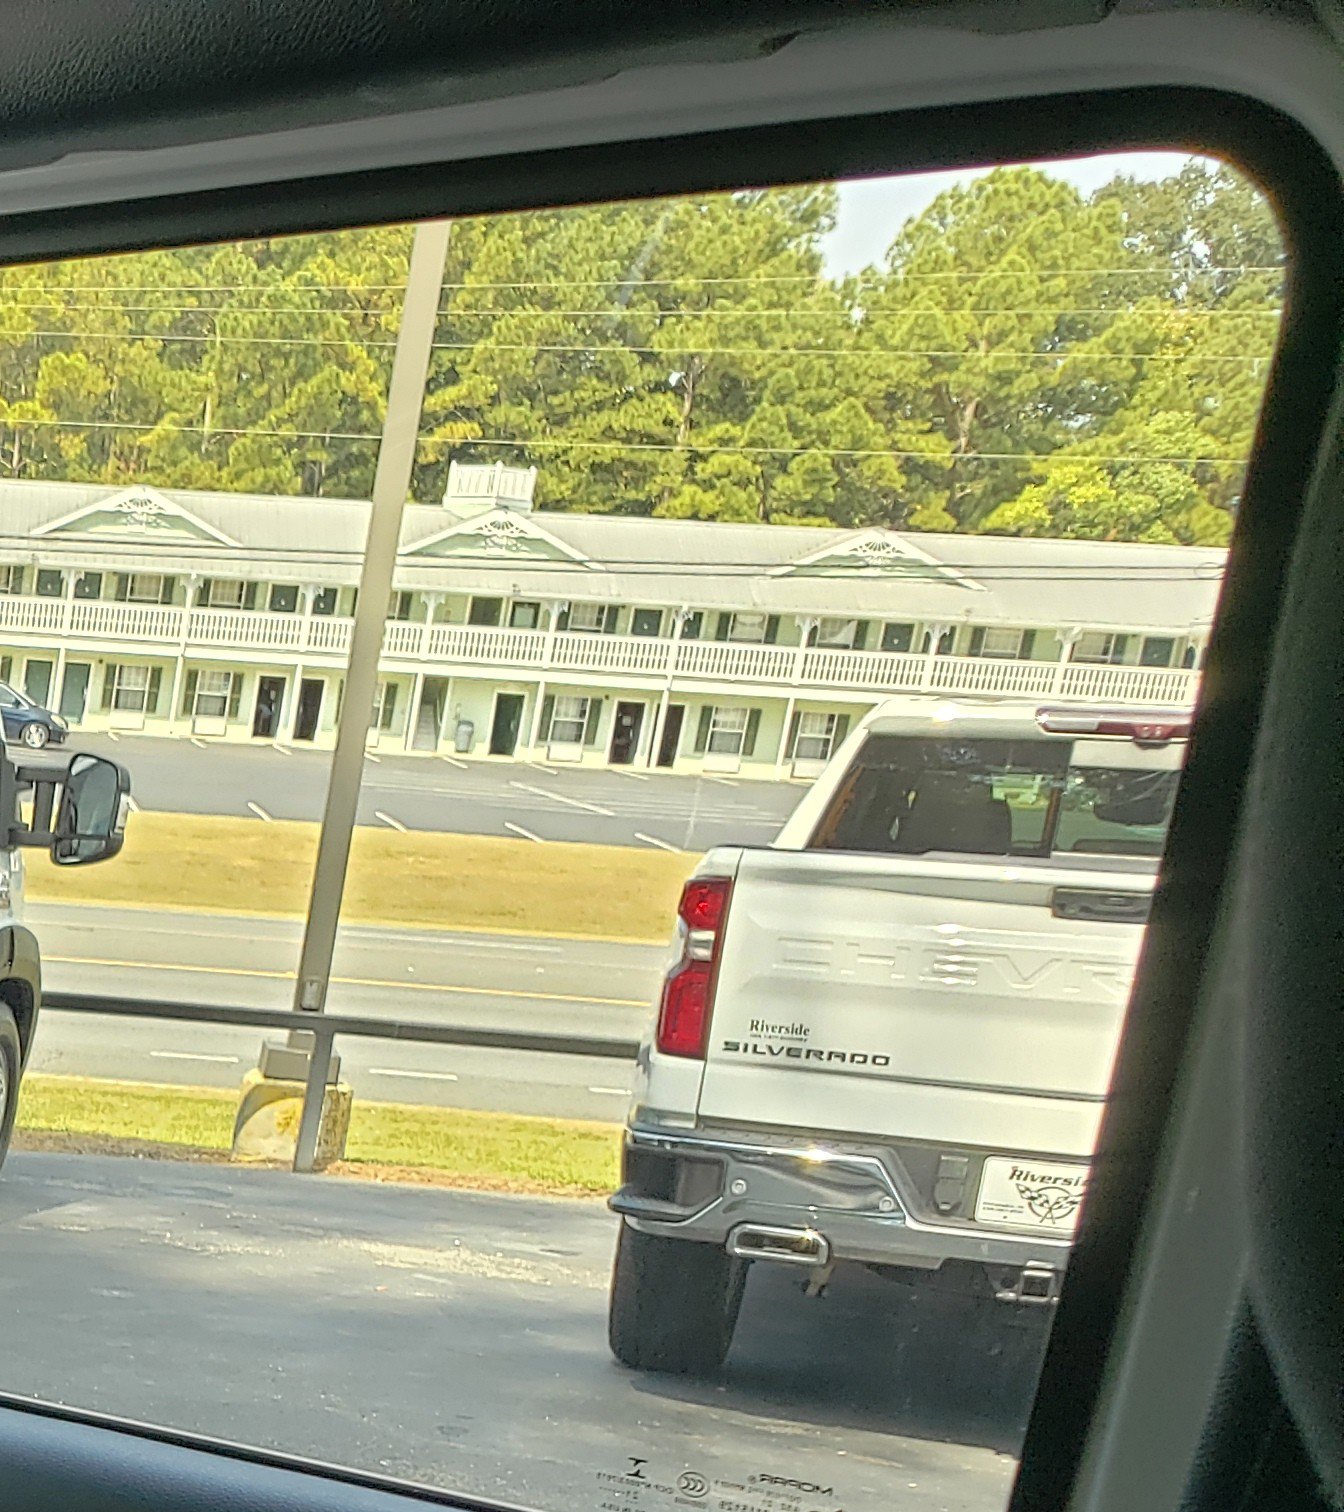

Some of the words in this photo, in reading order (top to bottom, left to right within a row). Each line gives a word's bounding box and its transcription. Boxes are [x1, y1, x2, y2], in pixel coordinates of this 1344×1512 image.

[772, 937, 1136, 997] CHEVR
[749, 1018, 811, 1037] Riverside
[722, 1040, 891, 1067] SILVERADO
[1009, 1165, 1086, 1187] Riversi
